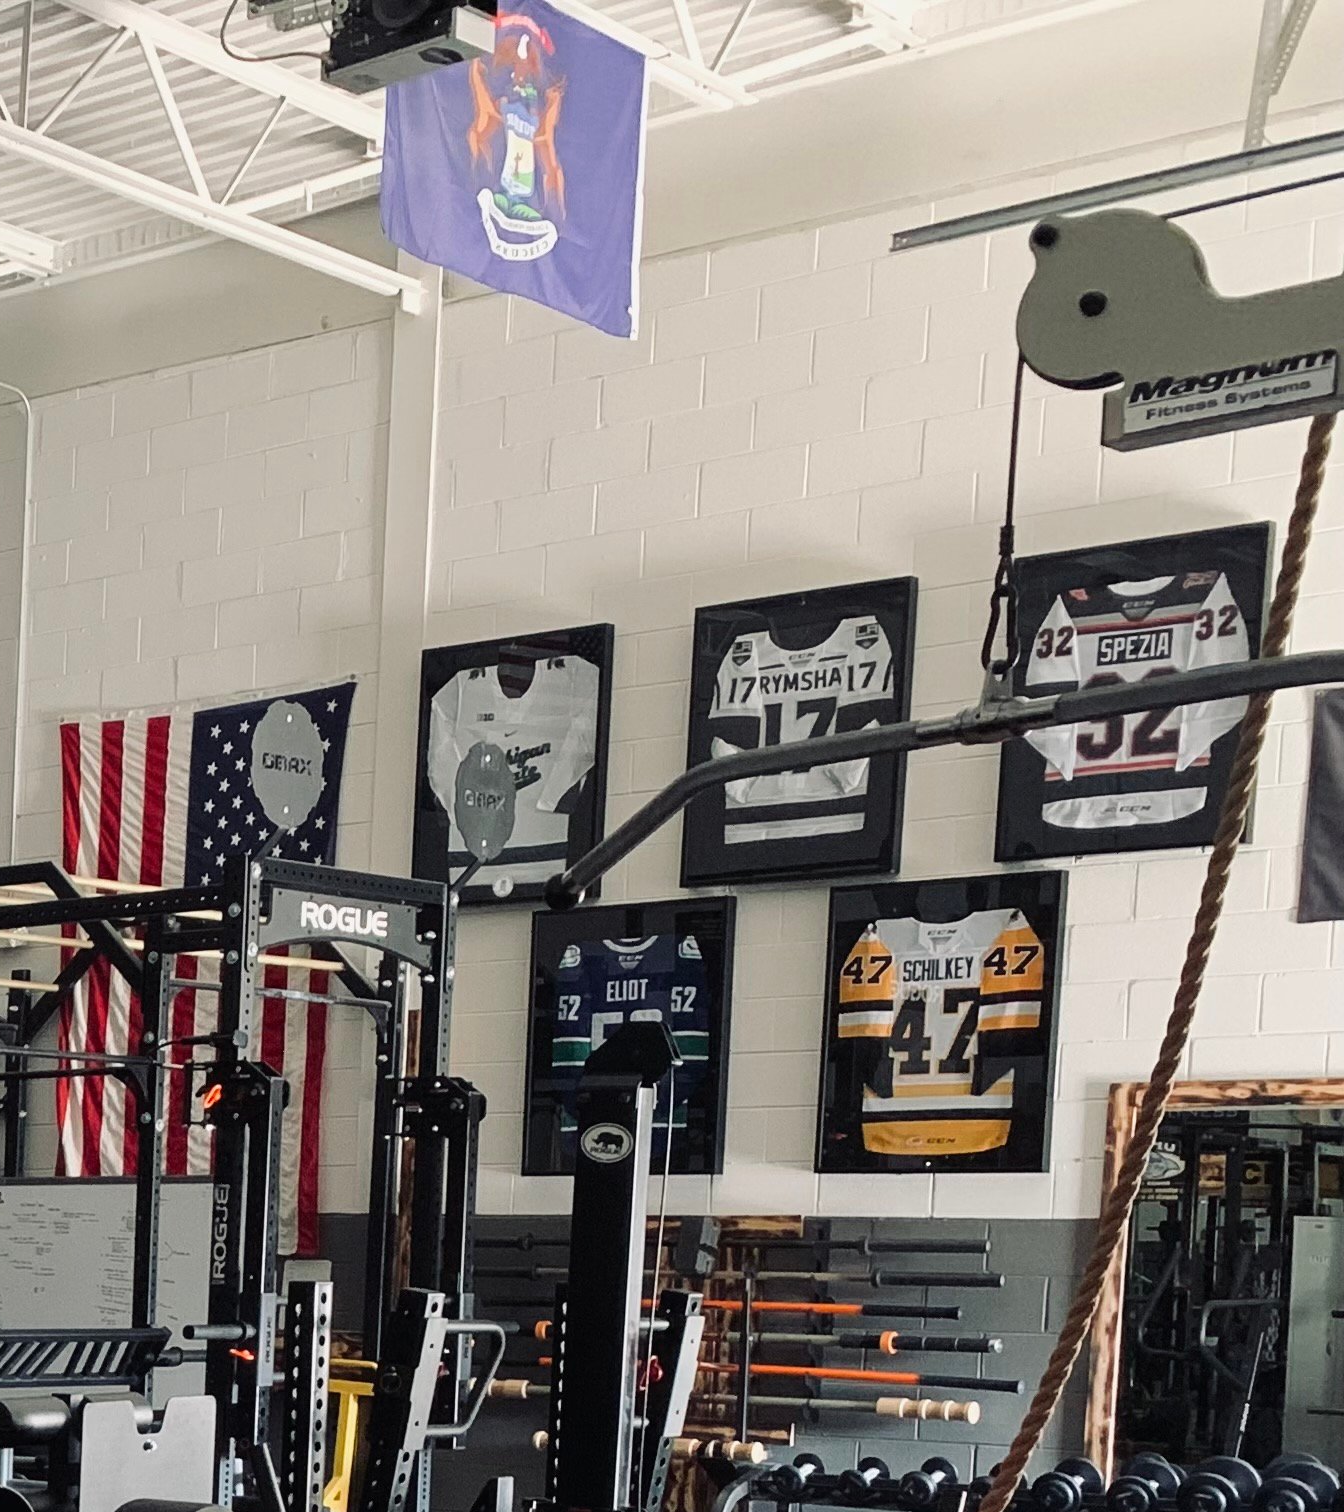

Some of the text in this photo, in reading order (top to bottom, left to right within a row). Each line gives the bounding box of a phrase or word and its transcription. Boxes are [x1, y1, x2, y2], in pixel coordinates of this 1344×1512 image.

[1128, 348, 1337, 405] Magnum
[1145, 379, 1312, 421] Fitness Systems
[1036, 603, 1240, 663] 32 SPEZIA 32
[728, 660, 877, 704] 17 RYMSHA 17
[300, 900, 389, 938] ROGUE
[843, 945, 1040, 984] 47 SCHILKEY 47
[558, 978, 697, 1021] 52 ELIOT 52
[888, 986, 981, 1076] 47
[211, 1183, 231, 1286] ROGUE
